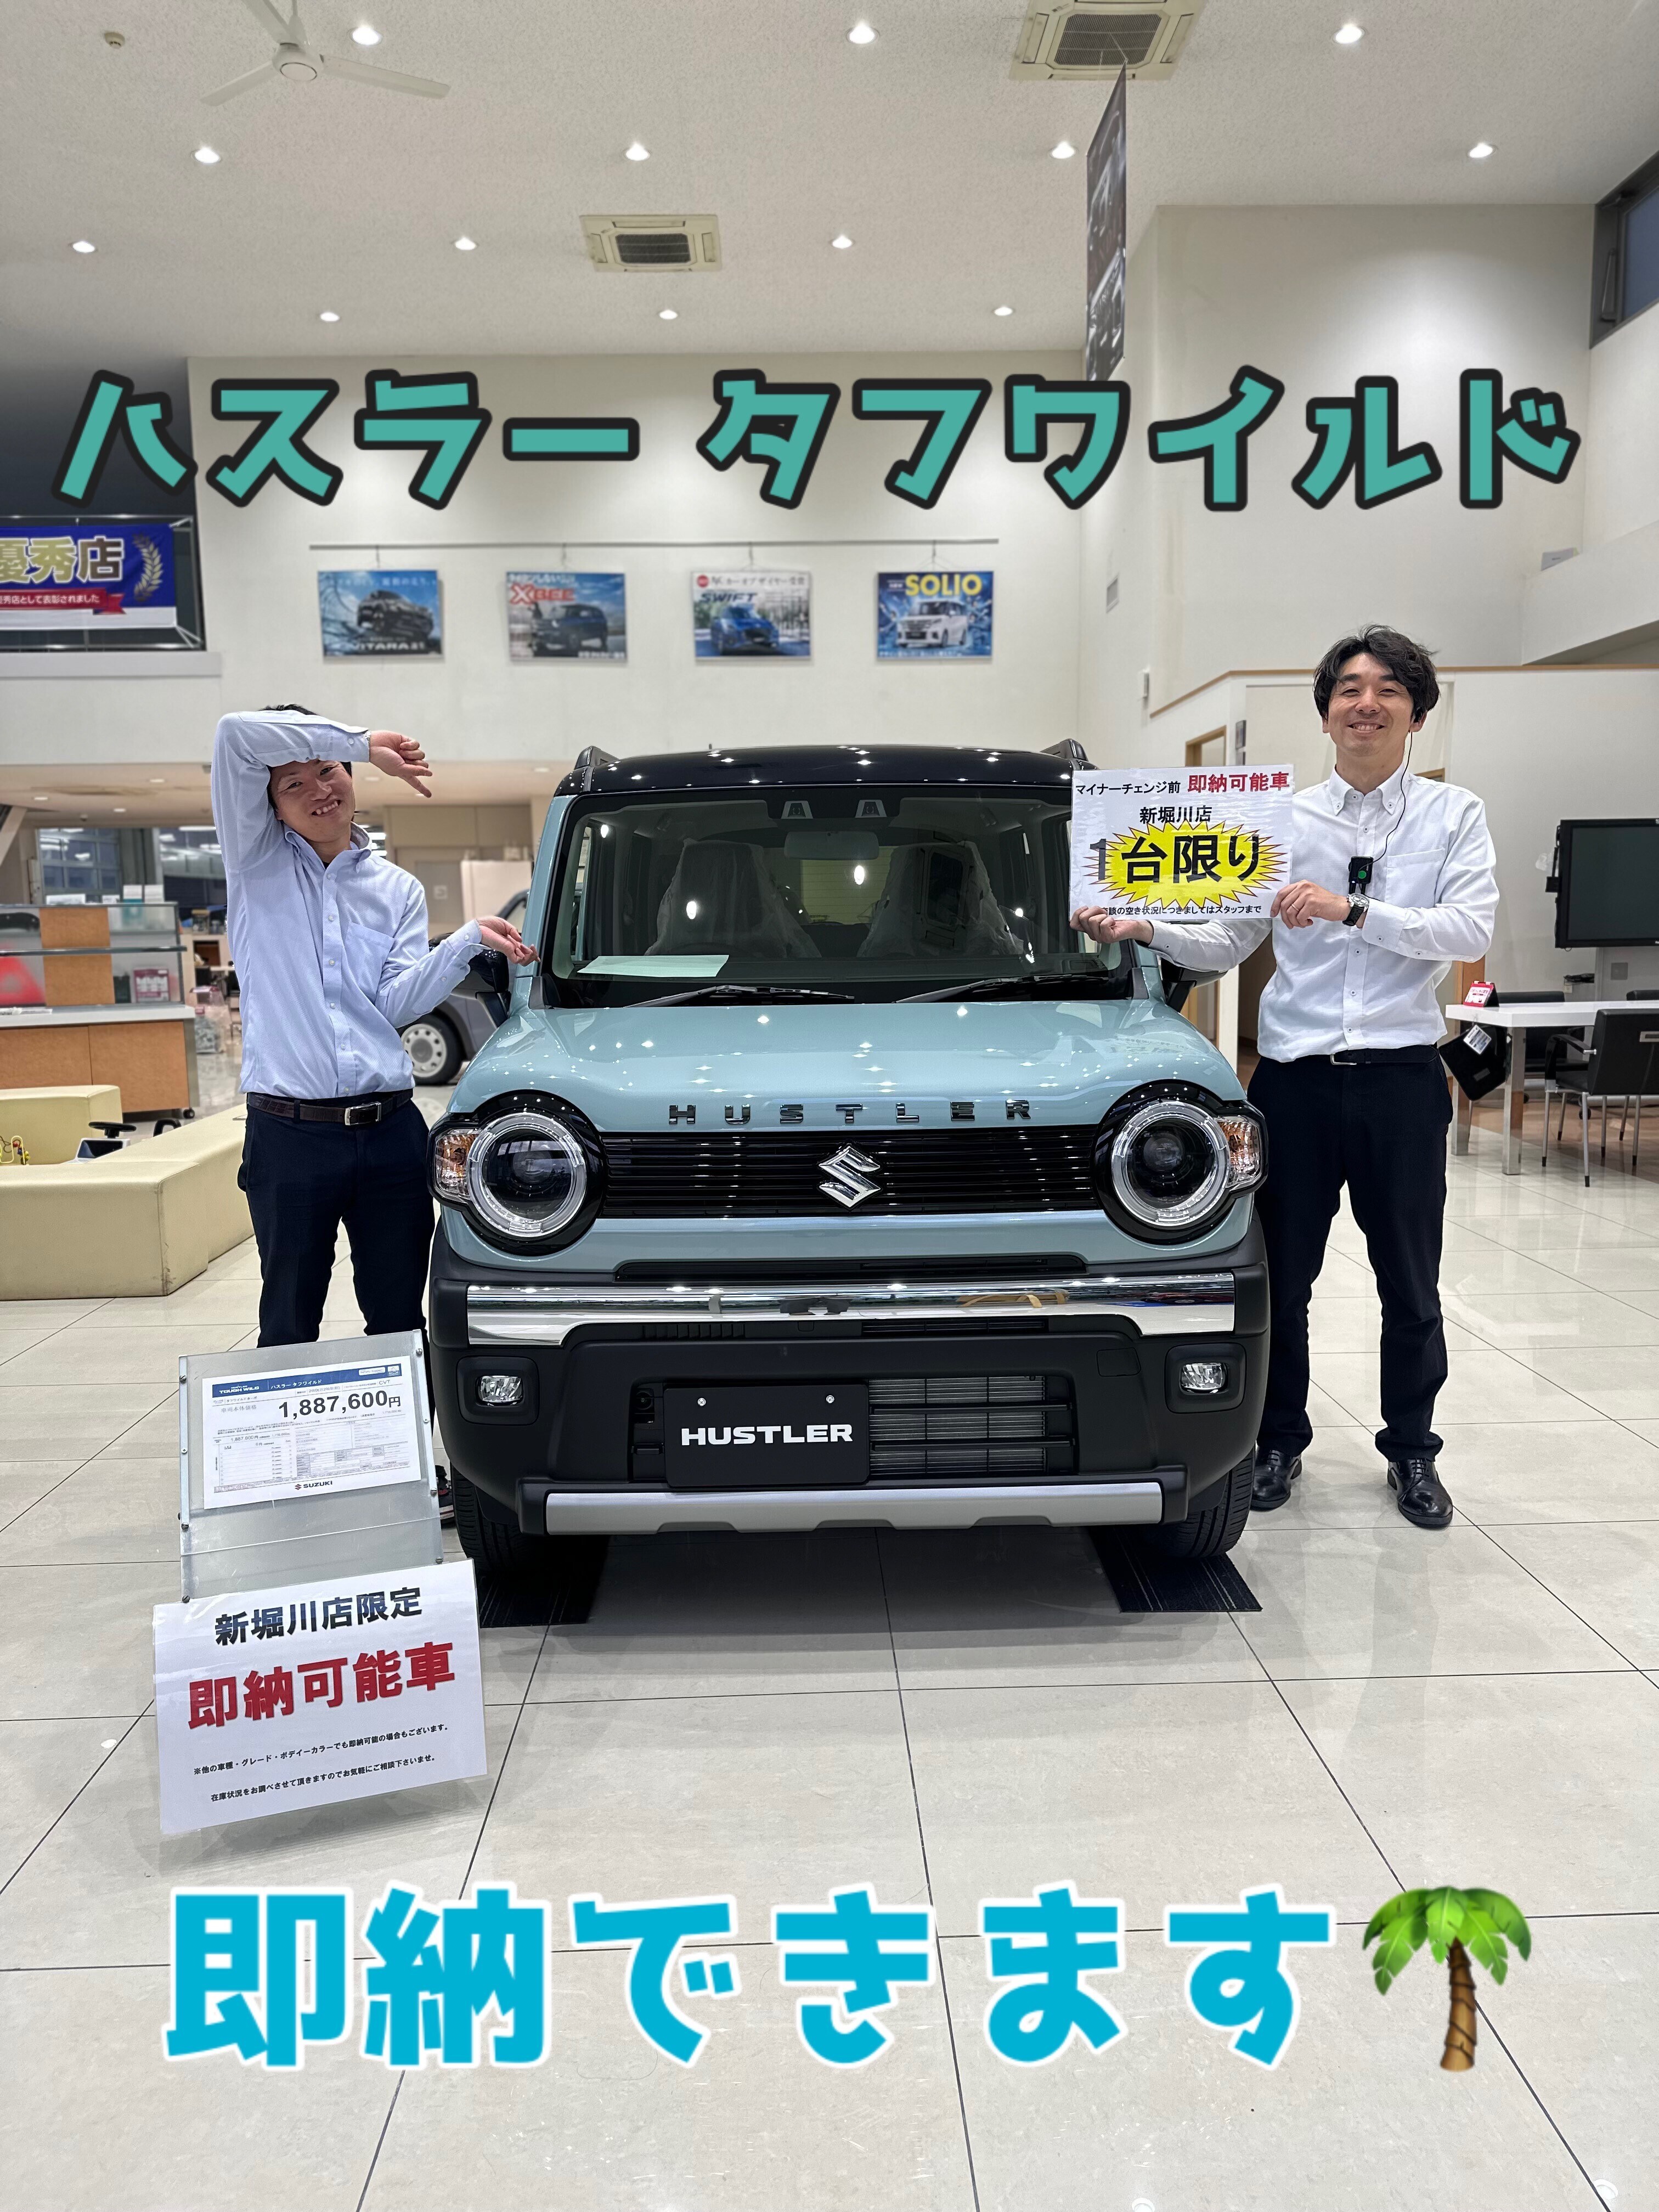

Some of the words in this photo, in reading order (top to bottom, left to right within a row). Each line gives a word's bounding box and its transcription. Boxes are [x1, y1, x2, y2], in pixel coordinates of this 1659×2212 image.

[699, 592, 758, 602] SWIFT
[905, 574, 982, 596] SOLIO
[1075, 781, 1181, 795] マイナーチェンジ前
[1187, 771, 1290, 793] 即納可能車
[1139, 805, 1212, 824] 新堀川店
[1090, 833, 1260, 884] 1台限り
[669, 1099, 1031, 1124] HUSTLER
[279, 1390, 401, 1420] 1,887,600円
[681, 1424, 853, 1446] HUSTLER
[303, 1480, 333, 1488] SUZUKI
[215, 1587, 422, 1646] 新堀川店限定
[188, 1641, 455, 1729] 即納可能車
